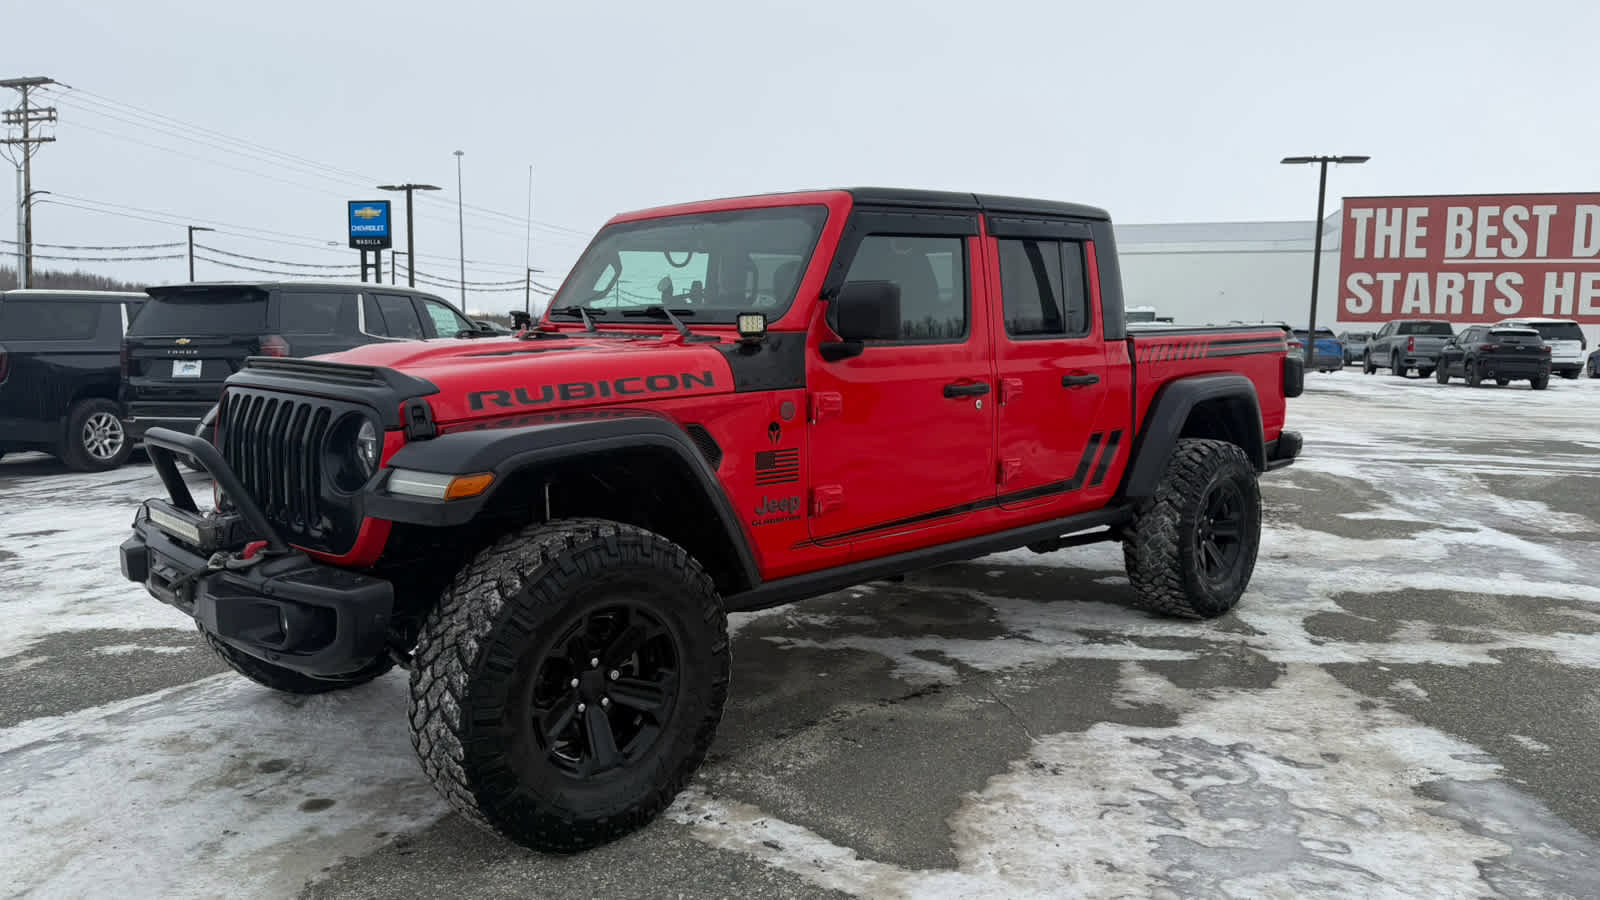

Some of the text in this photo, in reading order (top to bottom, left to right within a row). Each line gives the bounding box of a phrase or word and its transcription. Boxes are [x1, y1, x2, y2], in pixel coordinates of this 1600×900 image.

[1351, 207, 1429, 259] THE
[1444, 205, 1558, 258] BEST
[1345, 272, 1600, 315] STARTS HE
[467, 371, 715, 411] RUBICON
[754, 495, 801, 516] Jeep
